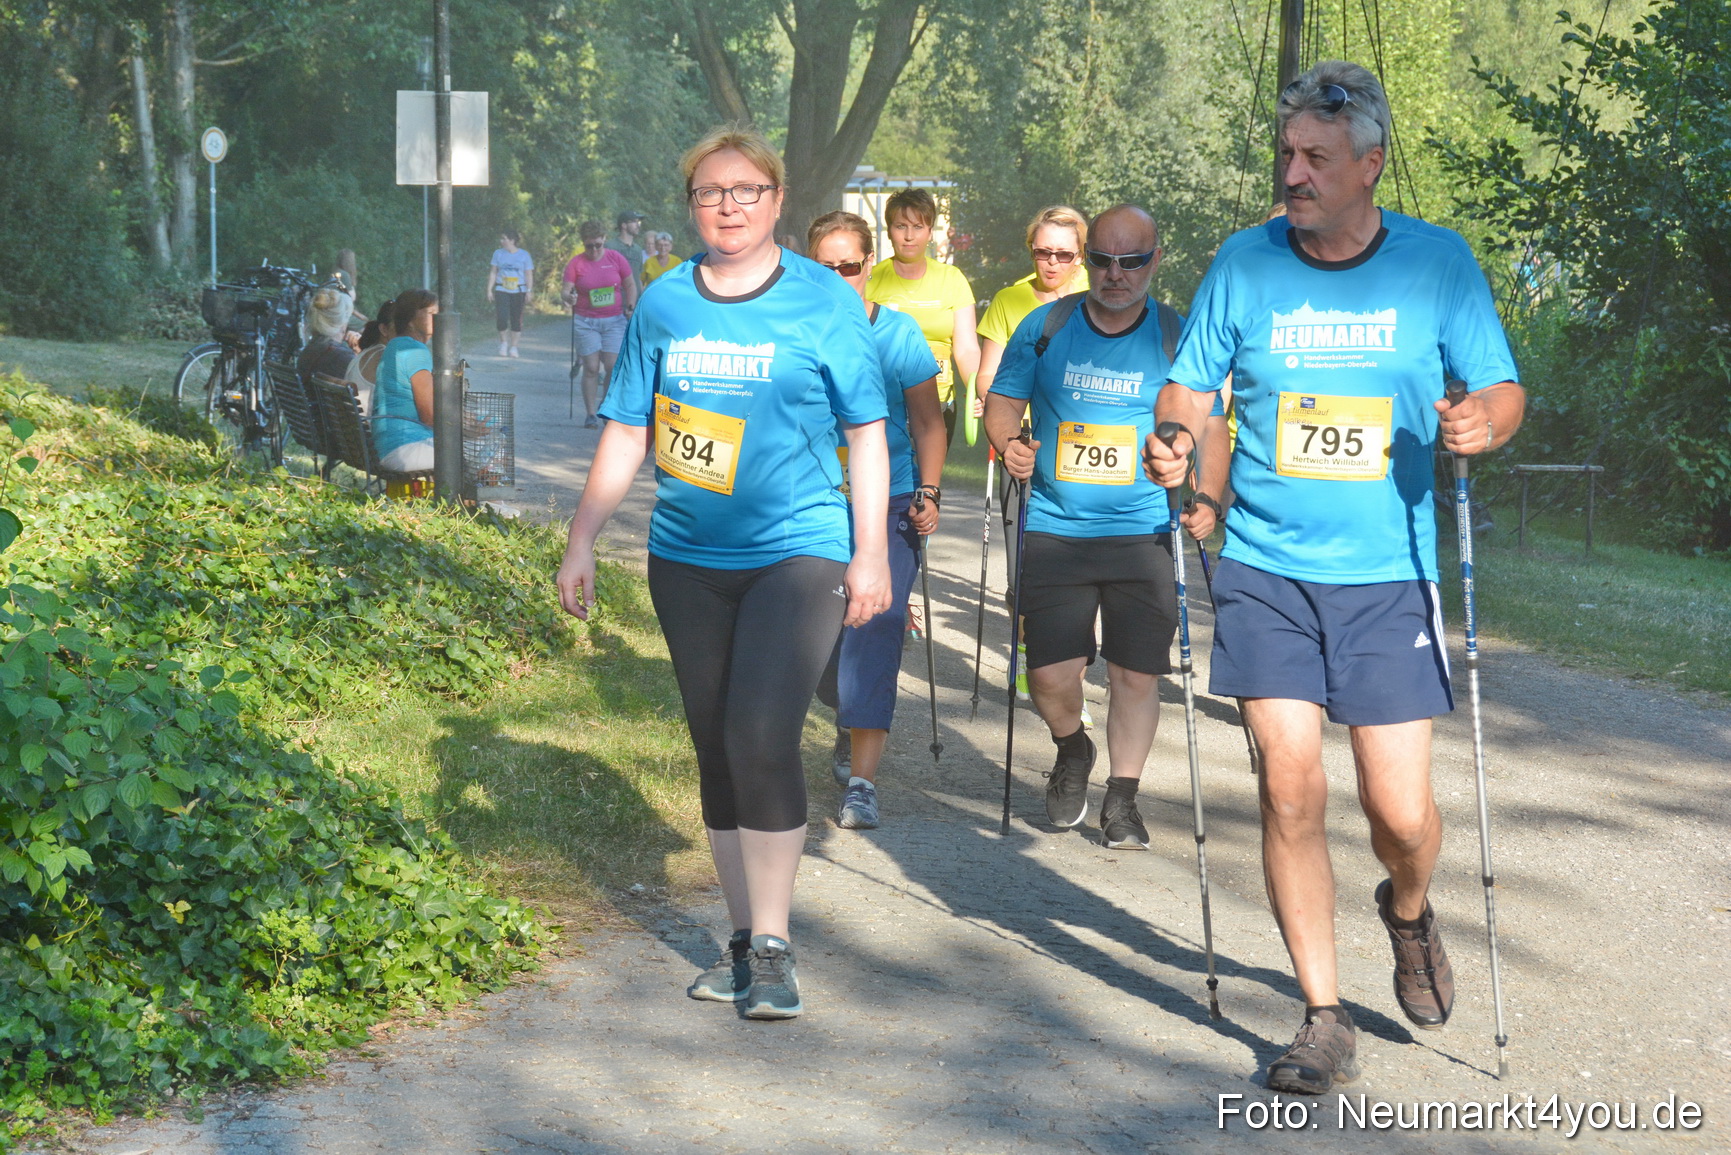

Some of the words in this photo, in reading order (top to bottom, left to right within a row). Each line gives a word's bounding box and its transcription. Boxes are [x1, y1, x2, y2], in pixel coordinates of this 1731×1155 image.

[594, 293, 612, 302] 2077
[1270, 324, 1396, 349] NEUMARKT
[666, 353, 773, 378] NEUMARKT
[1304, 361, 1378, 369] Niederbayern-Oberpfalz
[693, 380, 744, 389] Handwerkskammer
[1063, 372, 1142, 394] NEUMARKT
[693, 387, 753, 397] Niederbayern-Oberpfalz
[668, 427, 714, 467] 794
[1300, 425, 1363, 457] 795
[1074, 444, 1118, 468] 796
[1293, 456, 1329, 464] Hertwich
[1332, 458, 1369, 466] Willibald
[698, 466, 724, 479] Andrea
[1063, 465, 1082, 473] Burger
